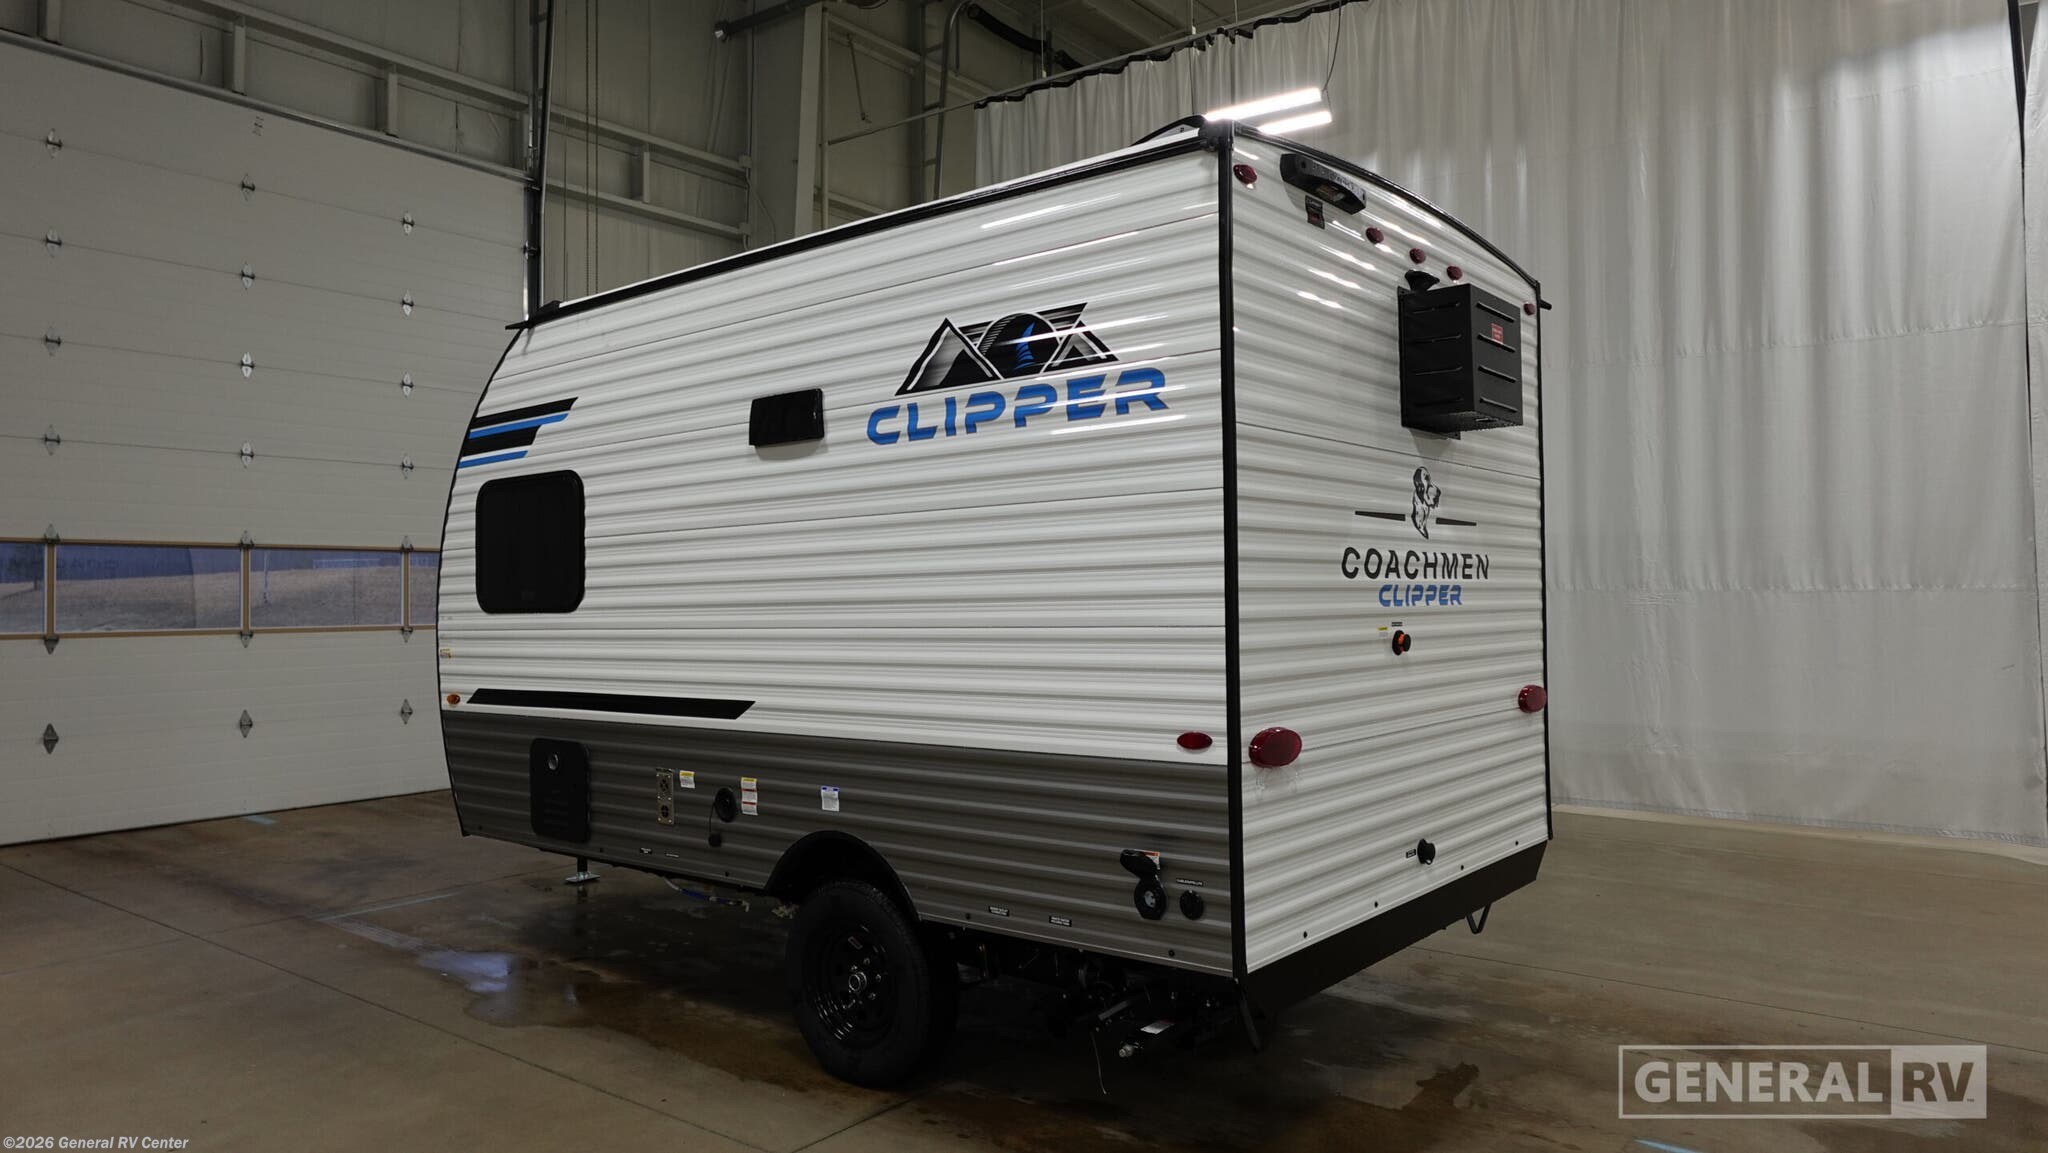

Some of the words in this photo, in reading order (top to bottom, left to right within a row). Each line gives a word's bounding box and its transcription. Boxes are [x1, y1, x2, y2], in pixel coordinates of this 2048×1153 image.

[866, 367, 1169, 446] CLIPPER
[1341, 546, 1490, 580] COACHMEN
[1378, 584, 1463, 607] CLIPPER
